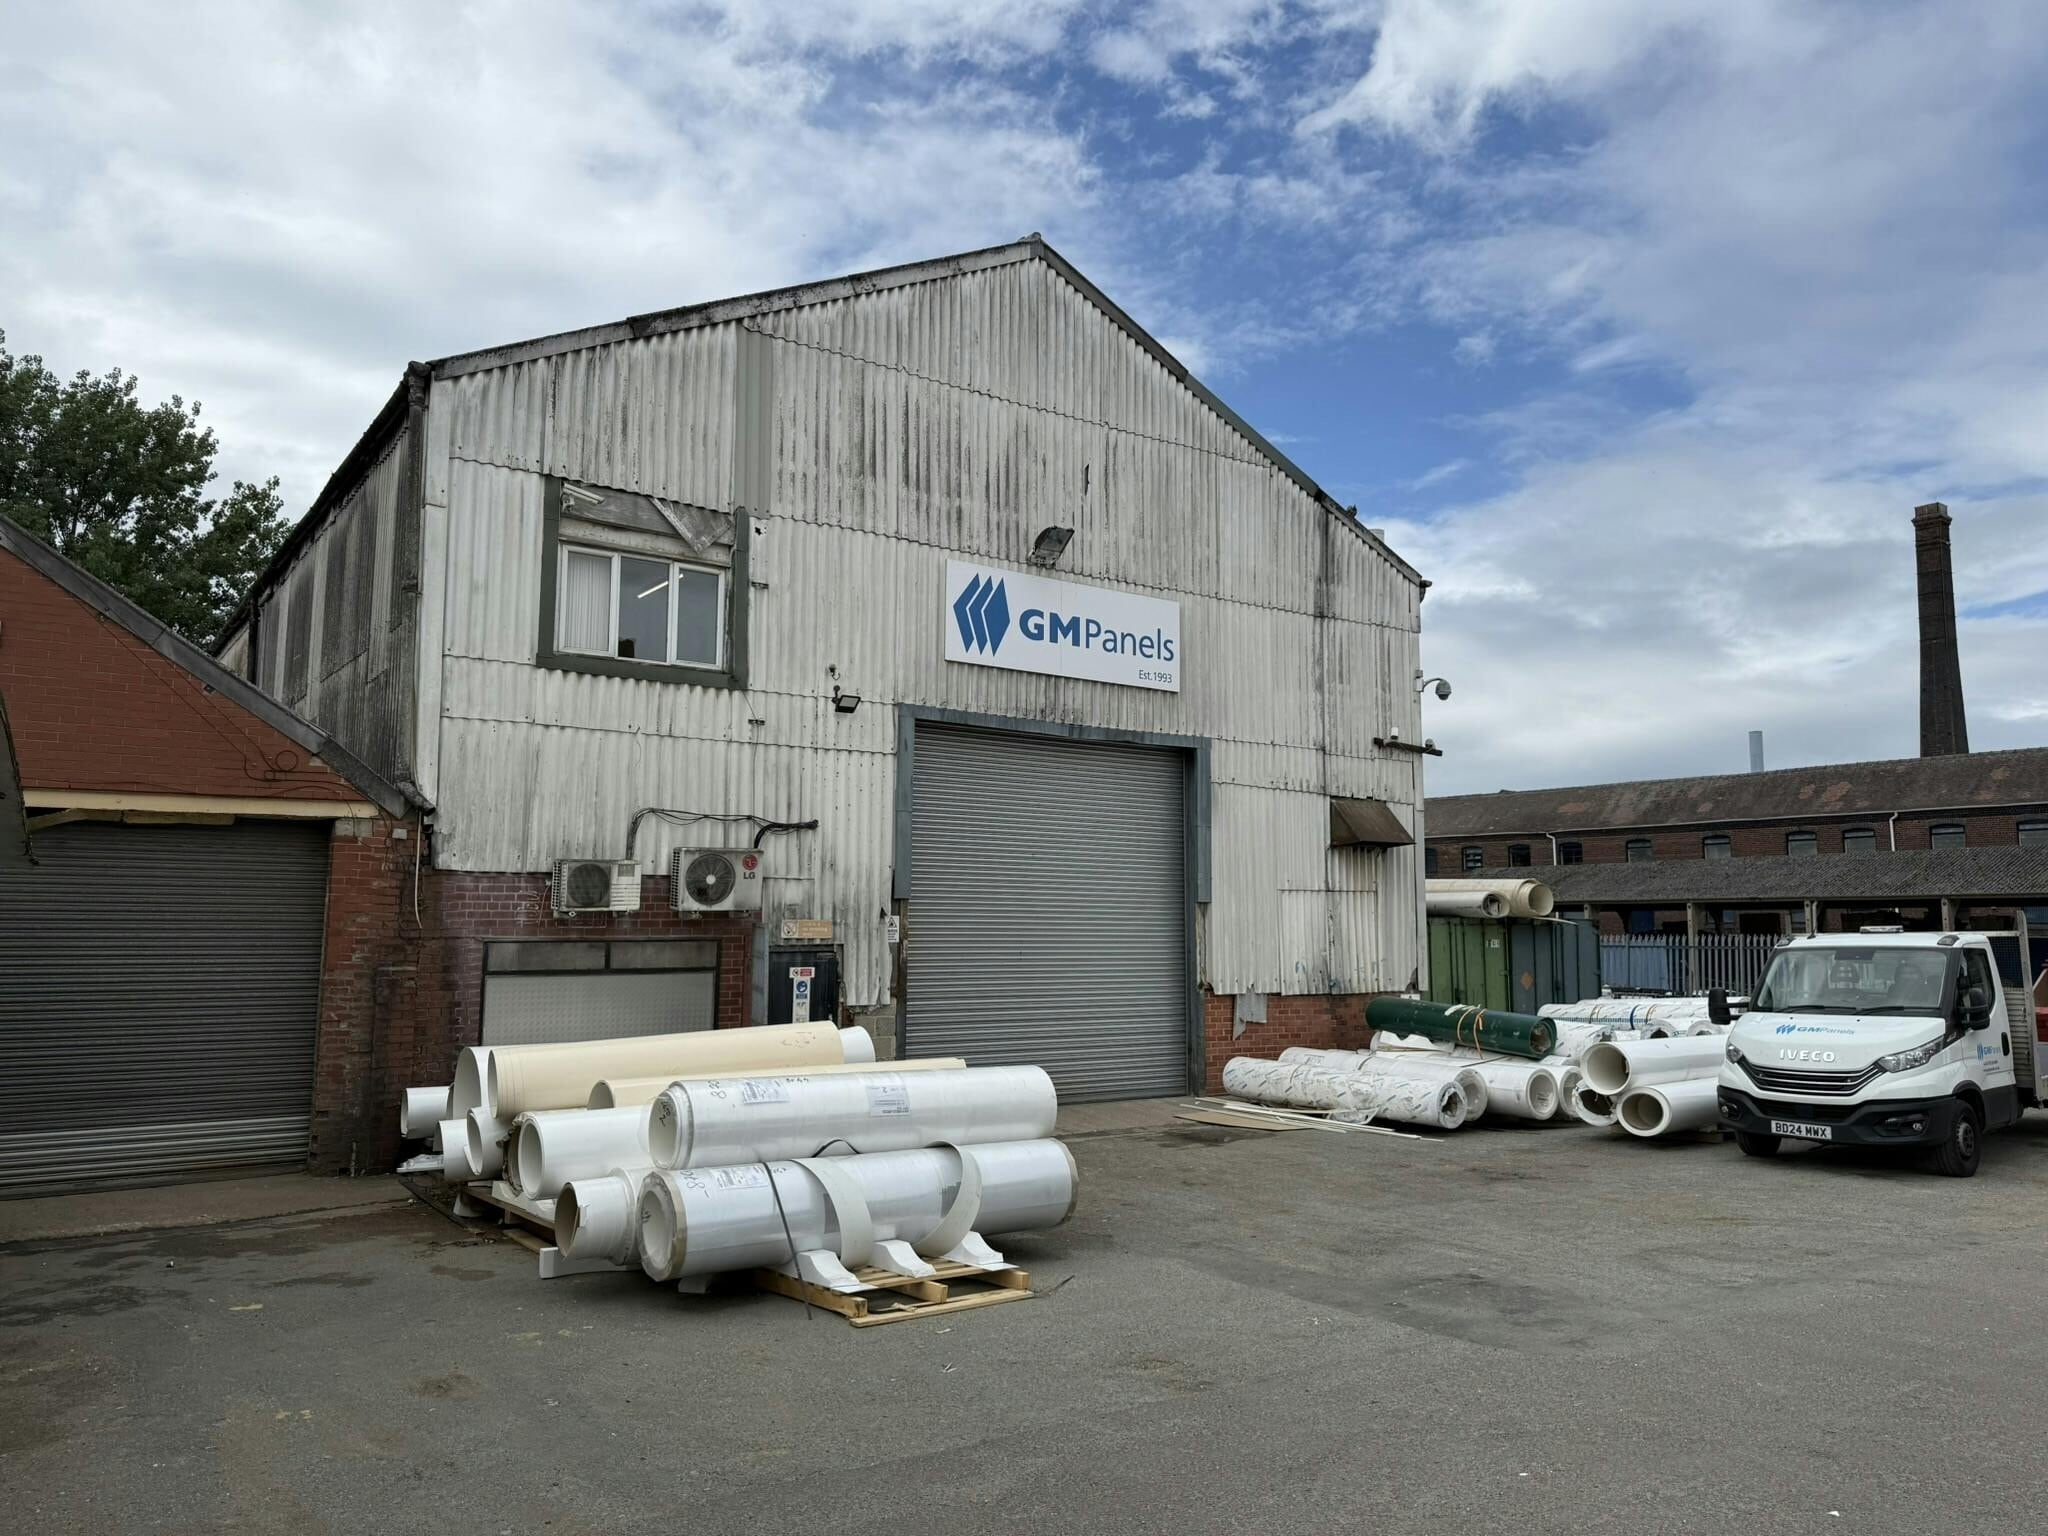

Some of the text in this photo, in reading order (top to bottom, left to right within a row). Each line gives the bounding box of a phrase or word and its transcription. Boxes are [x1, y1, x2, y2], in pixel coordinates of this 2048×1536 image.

[1019, 608, 1174, 662] GMPanels
[1138, 669, 1173, 684] Est.1993
[1779, 1048, 1835, 1063] IVECO
[1775, 1122, 1828, 1138] BD24 MWX
